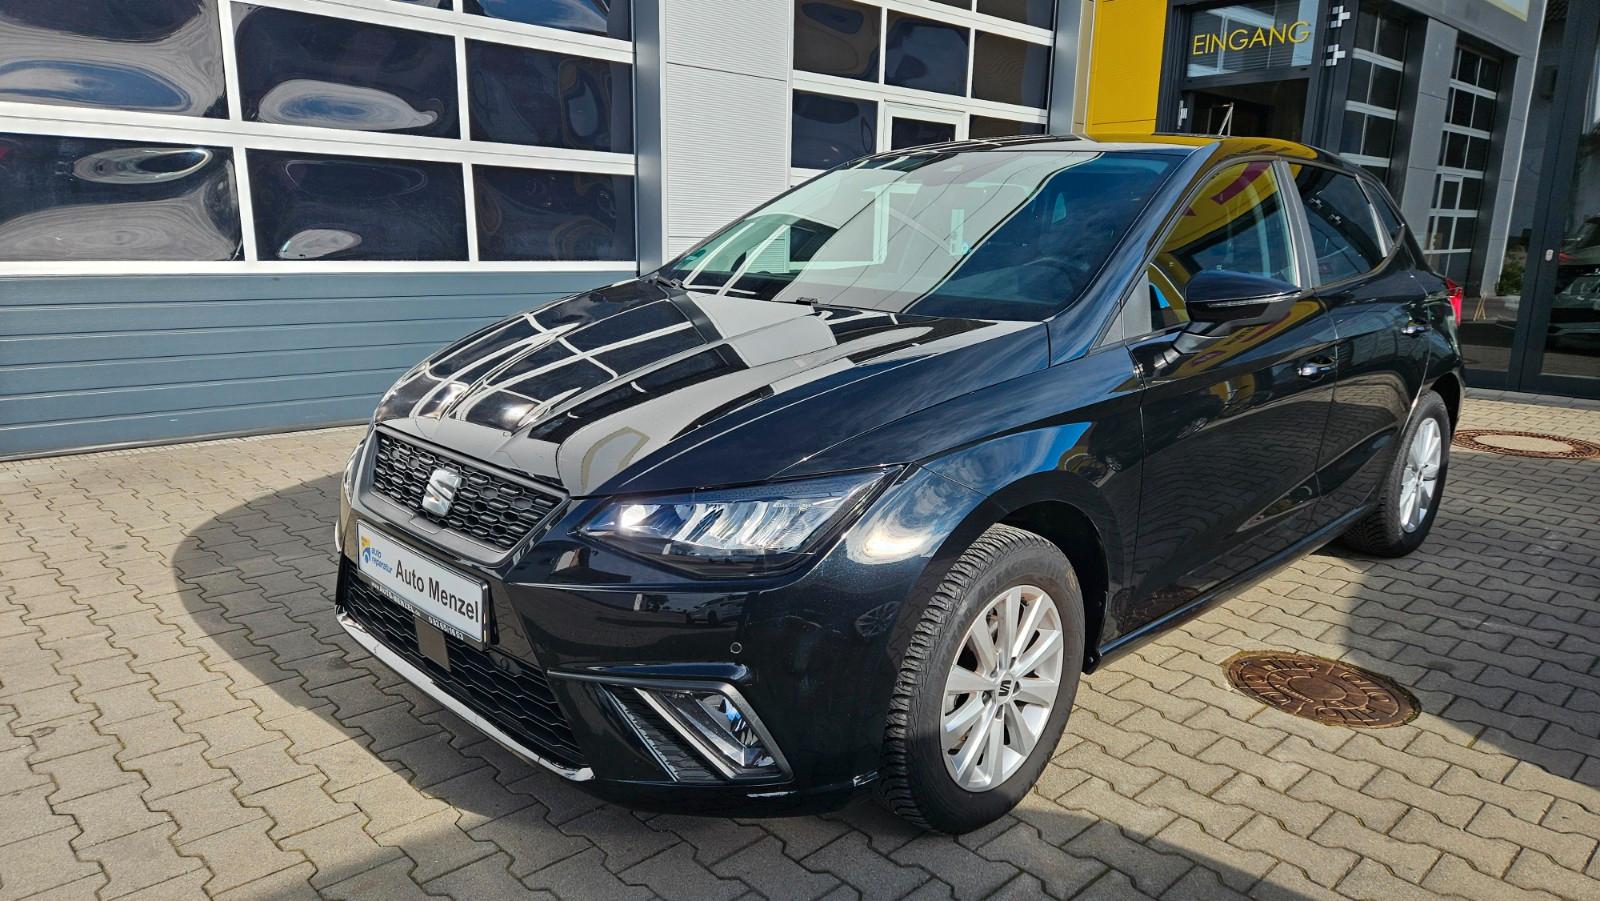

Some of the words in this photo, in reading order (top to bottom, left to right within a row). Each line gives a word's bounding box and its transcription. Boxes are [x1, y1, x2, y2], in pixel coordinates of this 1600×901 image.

[1192, 20, 1311, 55] EINGANG
[395, 559, 425, 593] Auto
[428, 576, 479, 623] Menzel
